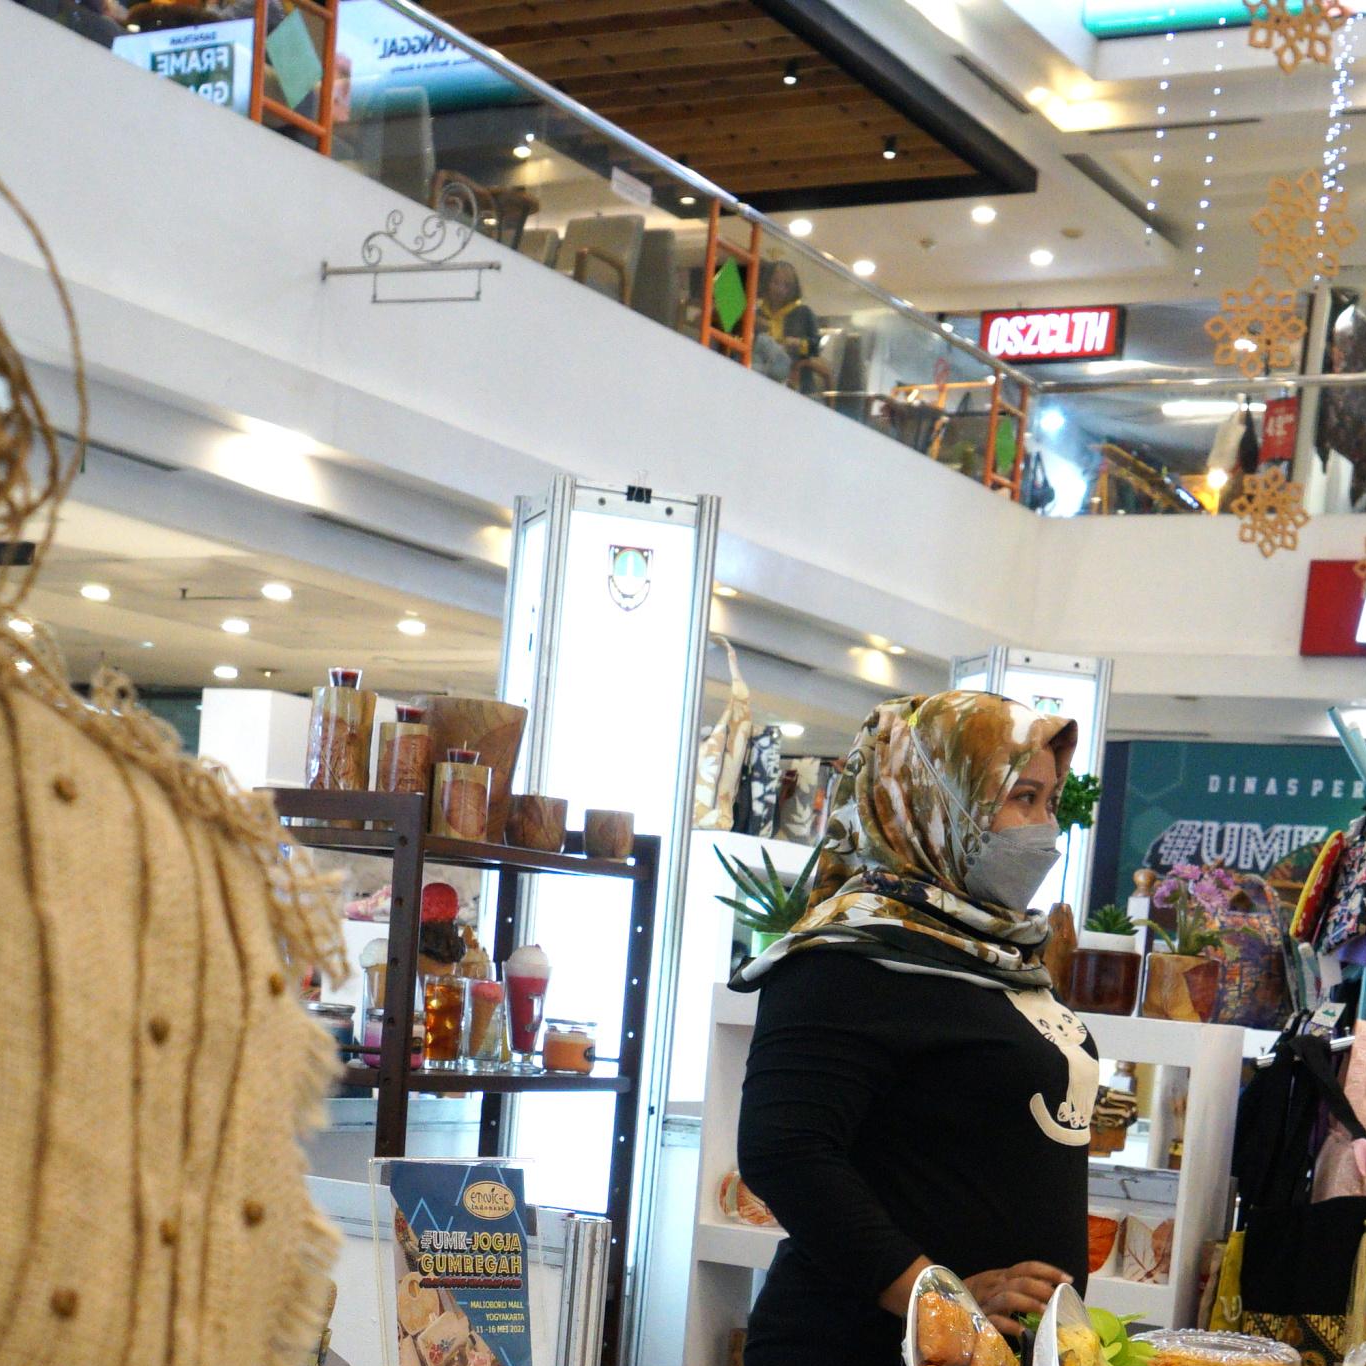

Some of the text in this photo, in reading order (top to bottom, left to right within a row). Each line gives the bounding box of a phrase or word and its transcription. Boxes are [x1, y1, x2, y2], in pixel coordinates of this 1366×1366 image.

[1207, 774, 1297, 797] DINAS
[418, 1254, 523, 1275] GUMREGAH
[470, 1301, 524, 1309] MALIOBORO MALL
[485, 1313, 525, 1321] YOGYAKARTA
[510, 1325, 525, 1333] 2022
